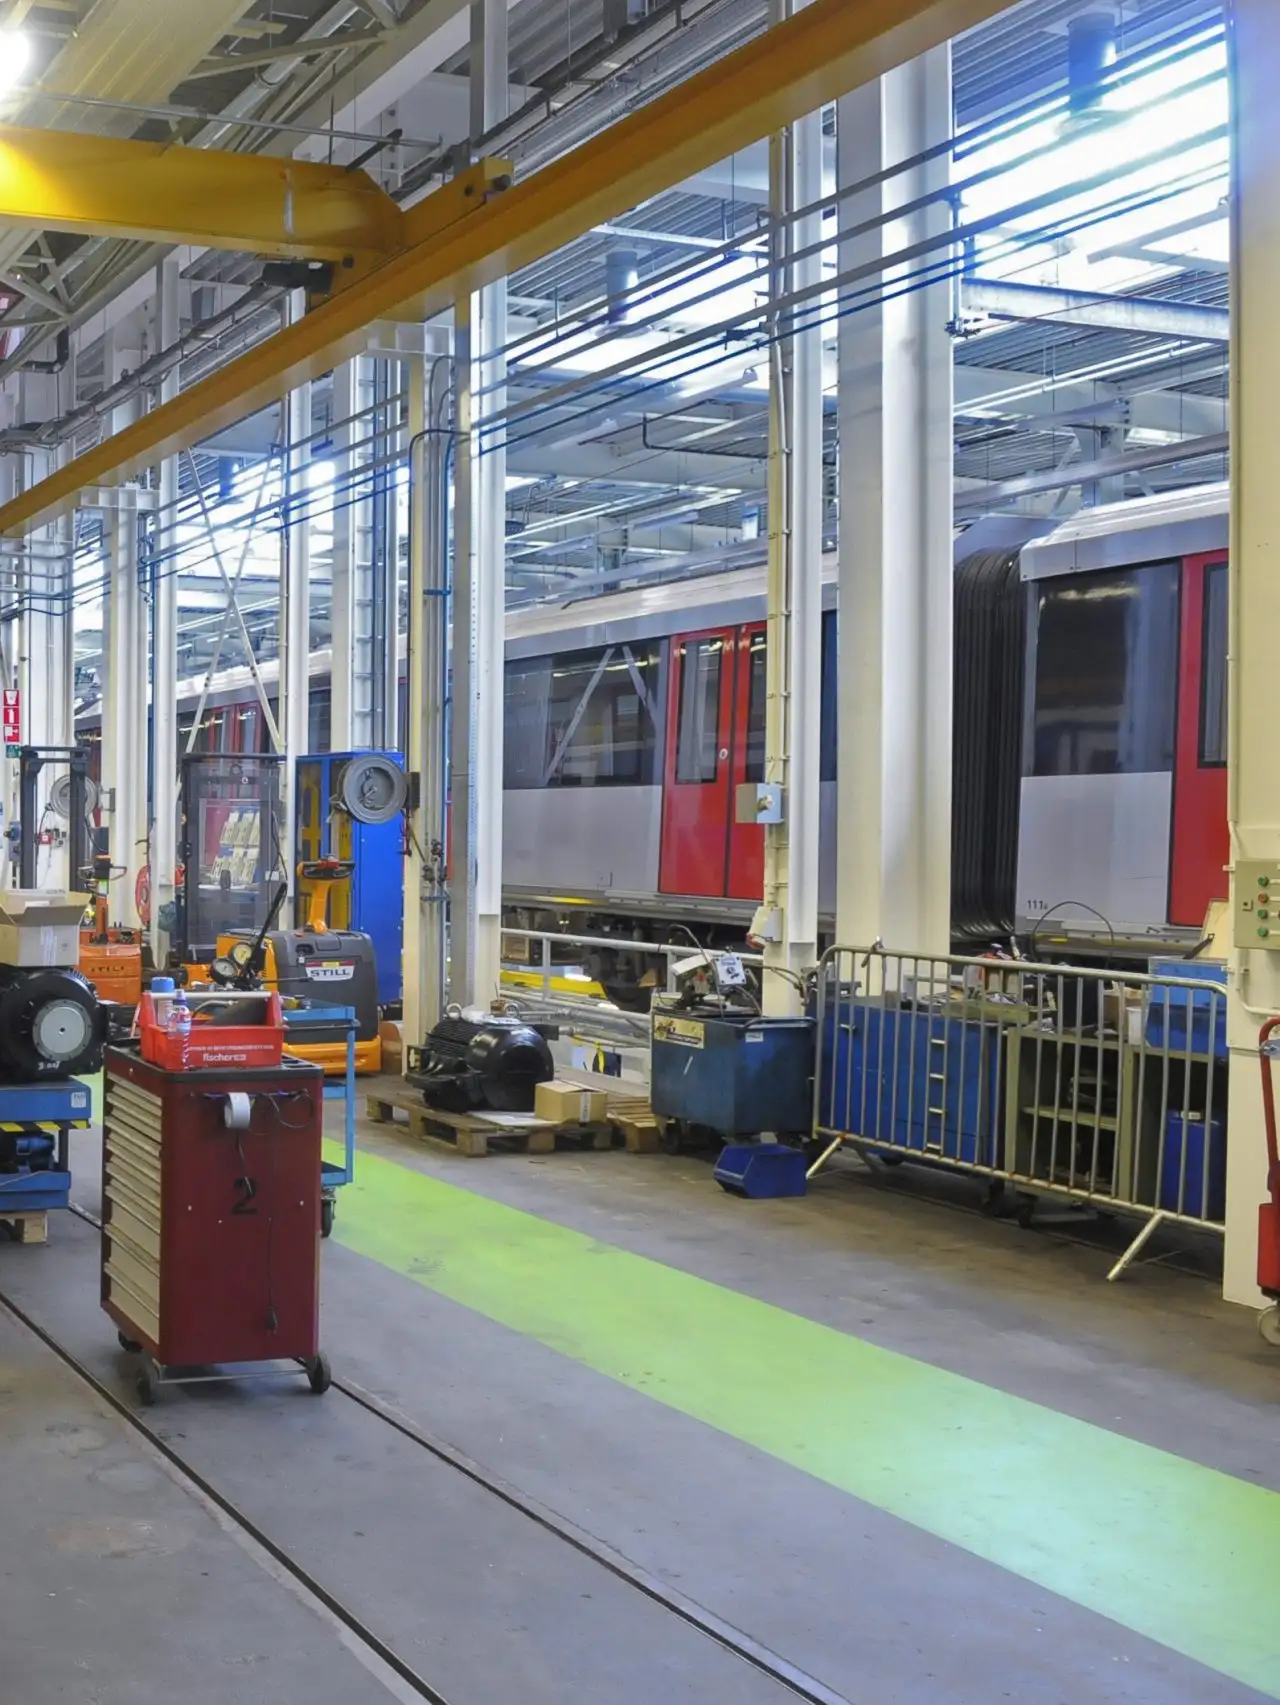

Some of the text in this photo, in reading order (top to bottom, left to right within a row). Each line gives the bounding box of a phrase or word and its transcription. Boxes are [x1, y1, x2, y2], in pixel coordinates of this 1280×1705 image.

[310, 968, 351, 977] STILL
[203, 1053, 235, 1062] fischer
[231, 1177, 258, 1216] 2
